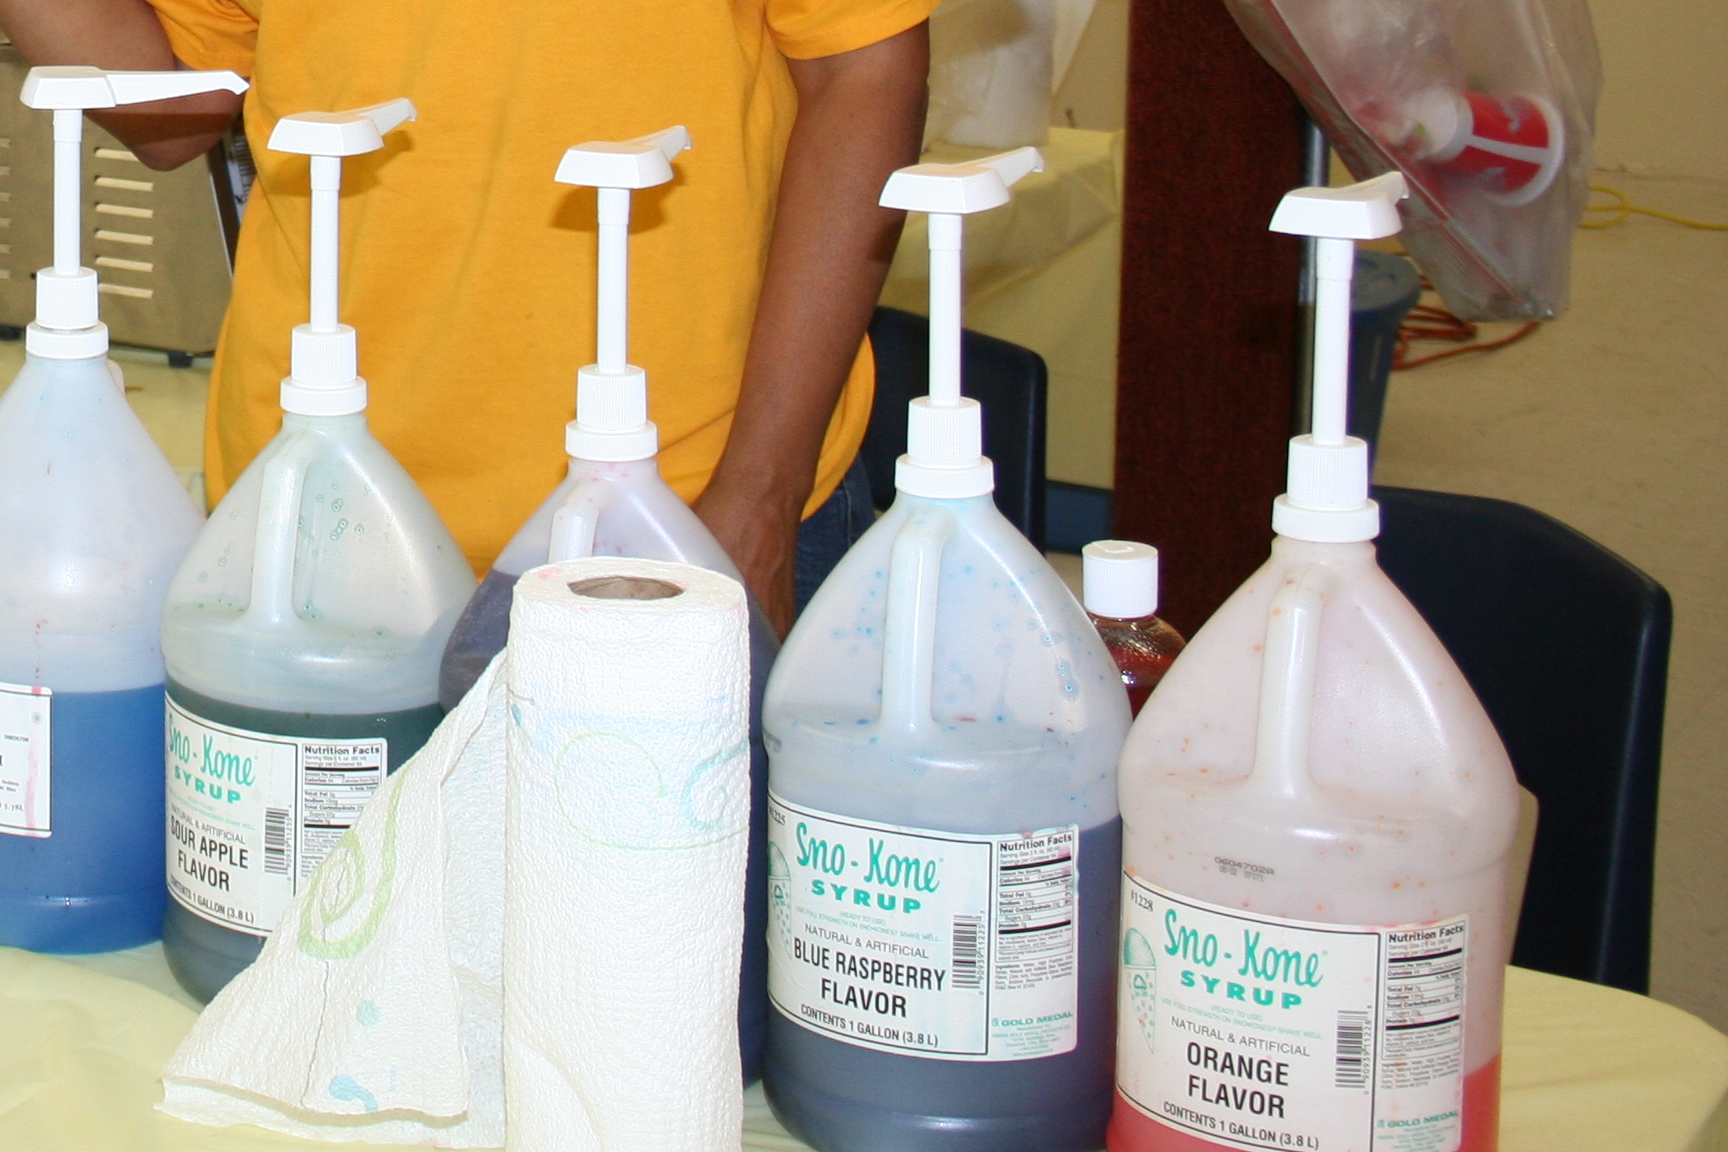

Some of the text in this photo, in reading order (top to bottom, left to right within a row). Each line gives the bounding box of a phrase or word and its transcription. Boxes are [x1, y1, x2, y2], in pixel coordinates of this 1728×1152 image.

[305, 745, 380, 755] Nutrition Facts
[174, 765, 241, 804] SYRUP
[199, 835, 249, 869] APPLE
[201, 822, 246, 845] ARTIFICIAL
[1000, 834, 1072, 852] Nutrition Facts
[178, 848, 230, 893] FLAVOR
[197, 894, 225, 915] GALLON
[811, 879, 921, 914] SYRUP
[805, 923, 851, 946] NATURAL
[855, 937, 862, 947] &
[865, 939, 929, 958] ARTIFICIAL
[1389, 925, 1464, 943] Nutrition Facts
[794, 937, 946, 992] BLUE RASPBERRY
[821, 978, 906, 1018] FLAVOR
[1180, 970, 1303, 1010] SYRUP
[801, 1004, 938, 1047] CONTENTS 1 GALLON (3.8 L)
[1001, 1012, 1072, 1026] GOLD MEDAL
[1171, 1015, 1224, 1041] NATURAL
[1227, 1032, 1236, 1044] &
[1238, 1036, 1310, 1057] ARTIFICIAL
[1187, 1041, 1290, 1087] ORANGE
[1187, 1074, 1285, 1119] FLAVOR
[1164, 1101, 1319, 1150] CONTENTS 1 GALLON (3.8 L)
[1387, 1110, 1458, 1128] GOLD MEDAL
